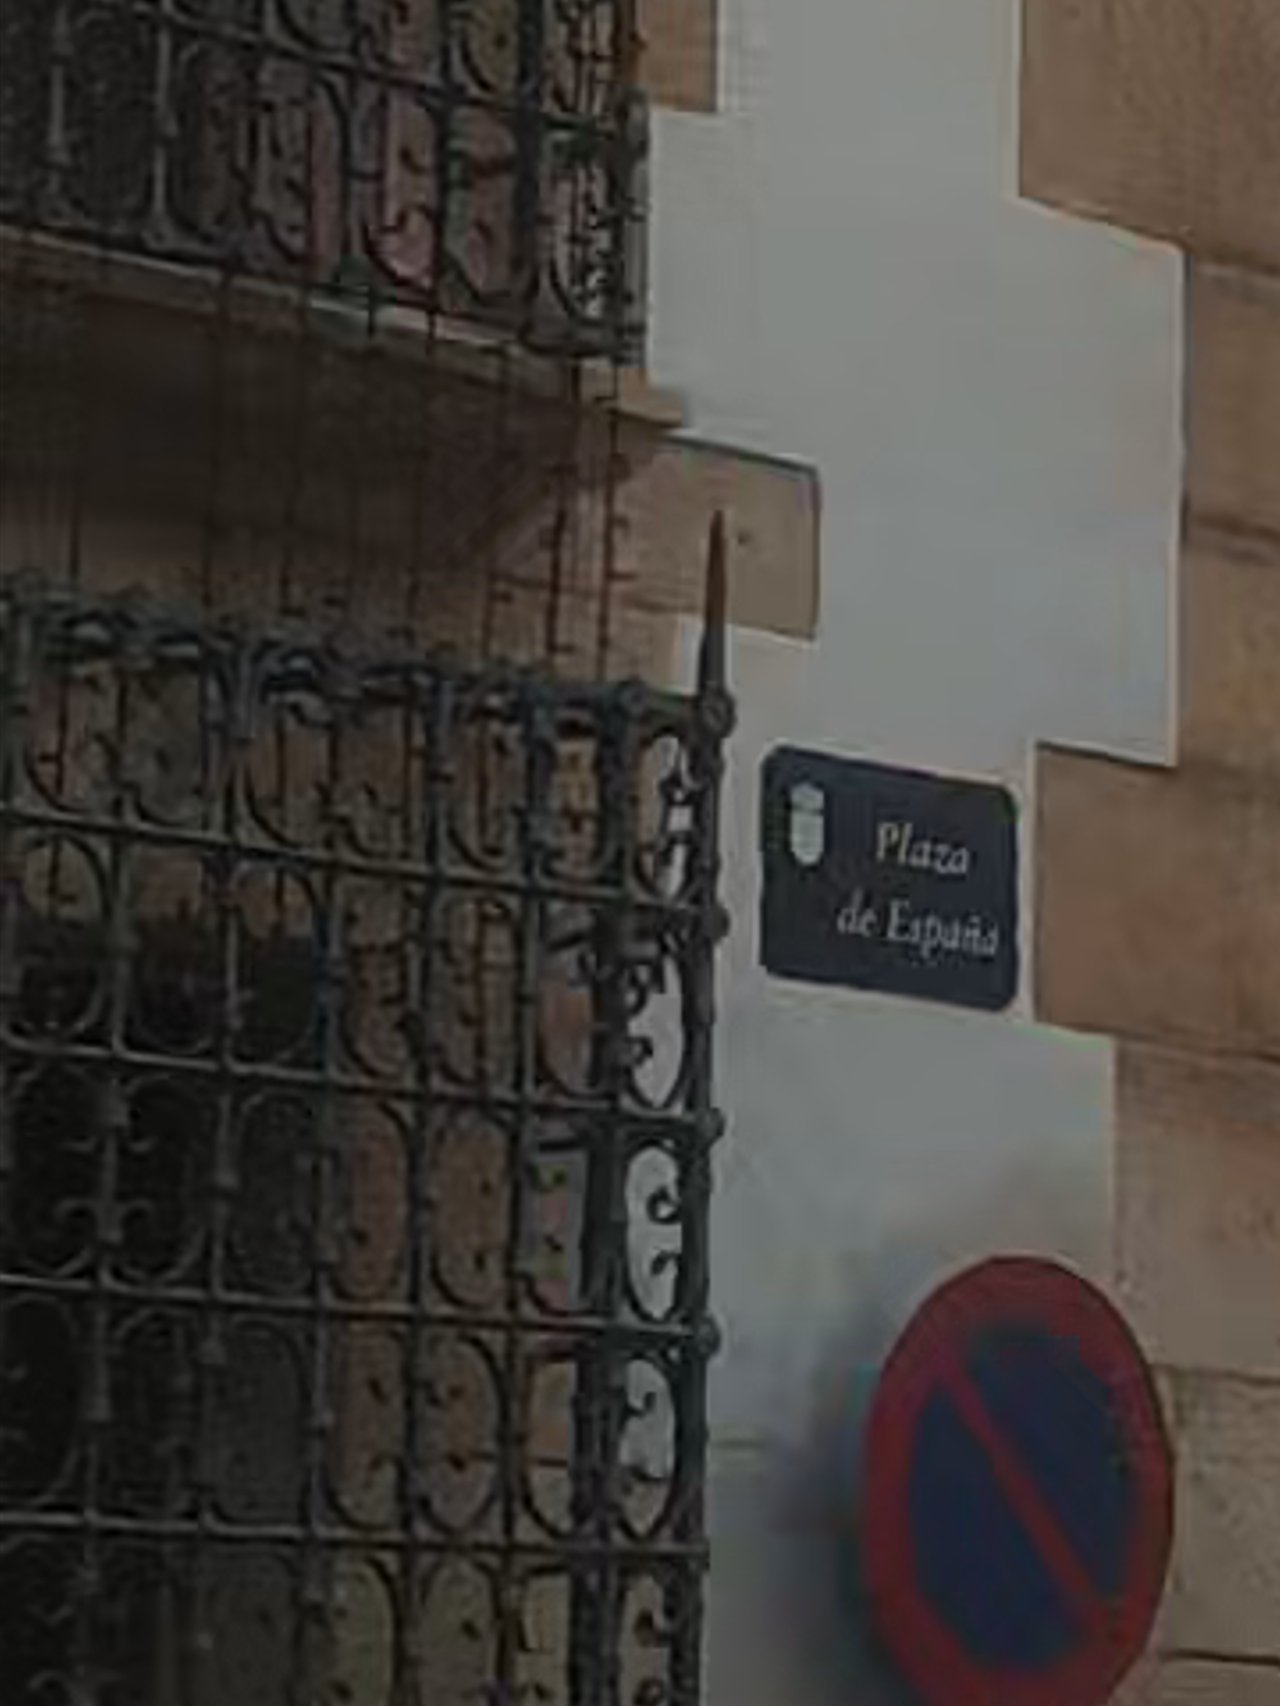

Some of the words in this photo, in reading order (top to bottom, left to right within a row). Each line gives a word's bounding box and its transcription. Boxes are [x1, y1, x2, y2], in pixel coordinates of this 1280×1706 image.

[876, 821, 970, 875] Plaza
[836, 888, 878, 937] de
[886, 897, 999, 959] España
